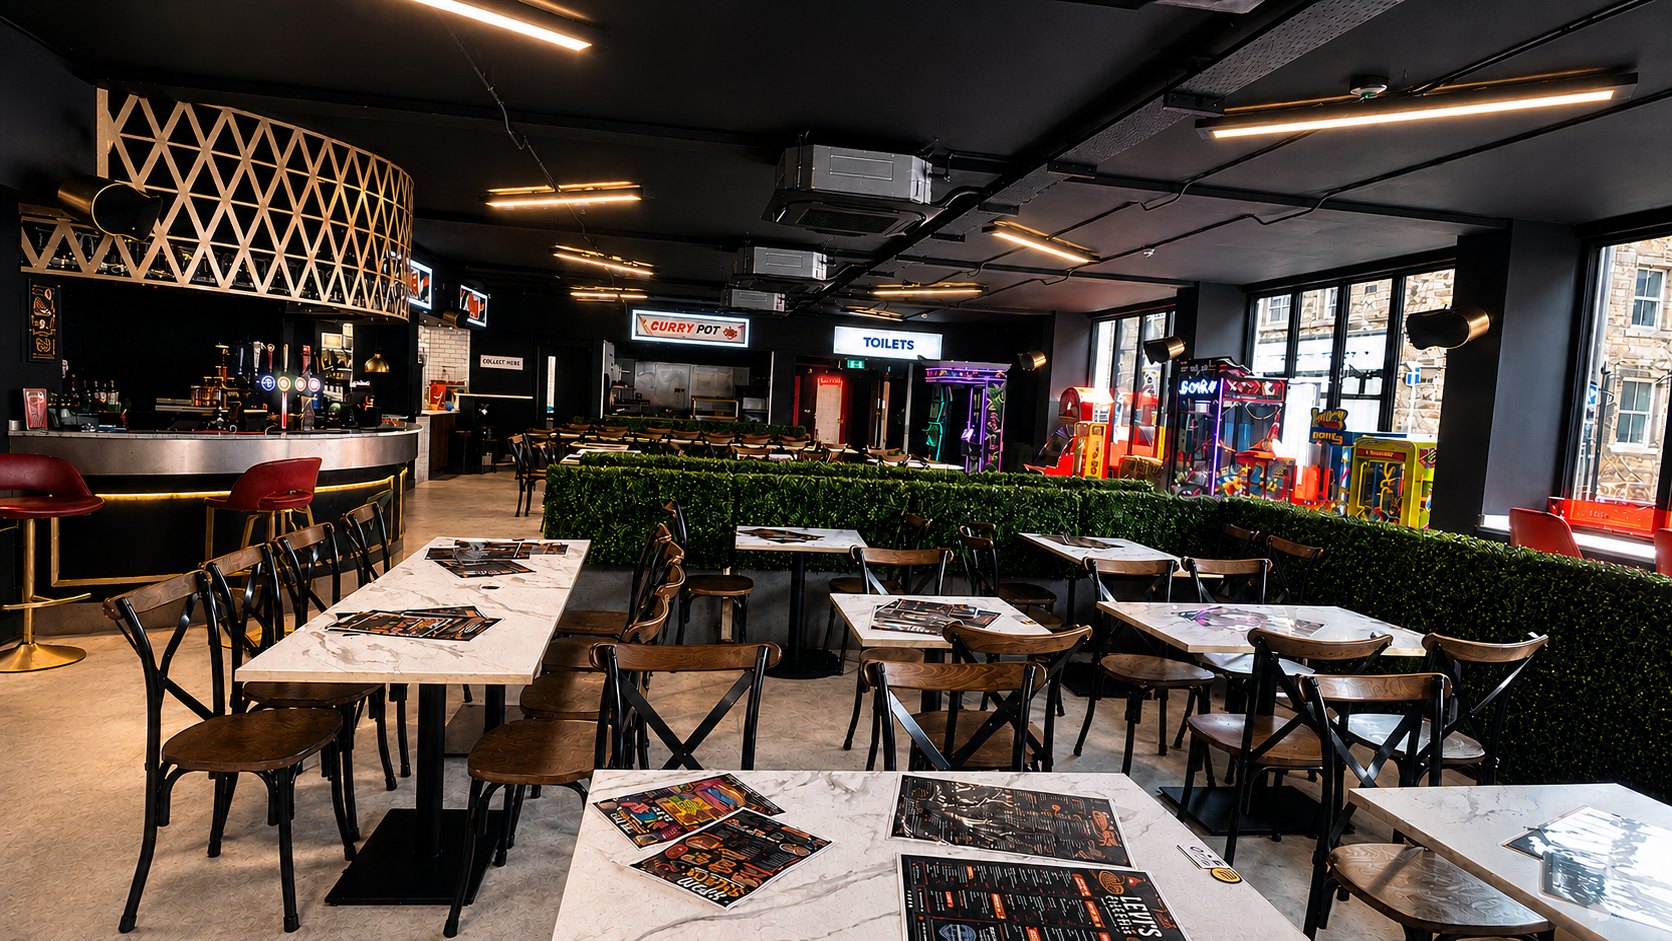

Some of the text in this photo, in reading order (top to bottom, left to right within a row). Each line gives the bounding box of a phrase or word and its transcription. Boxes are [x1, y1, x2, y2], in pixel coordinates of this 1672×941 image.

[650, 321, 720, 335] CURRY POT
[863, 337, 914, 350] TOILETS
[1120, 896, 1163, 937] LEVI'S
